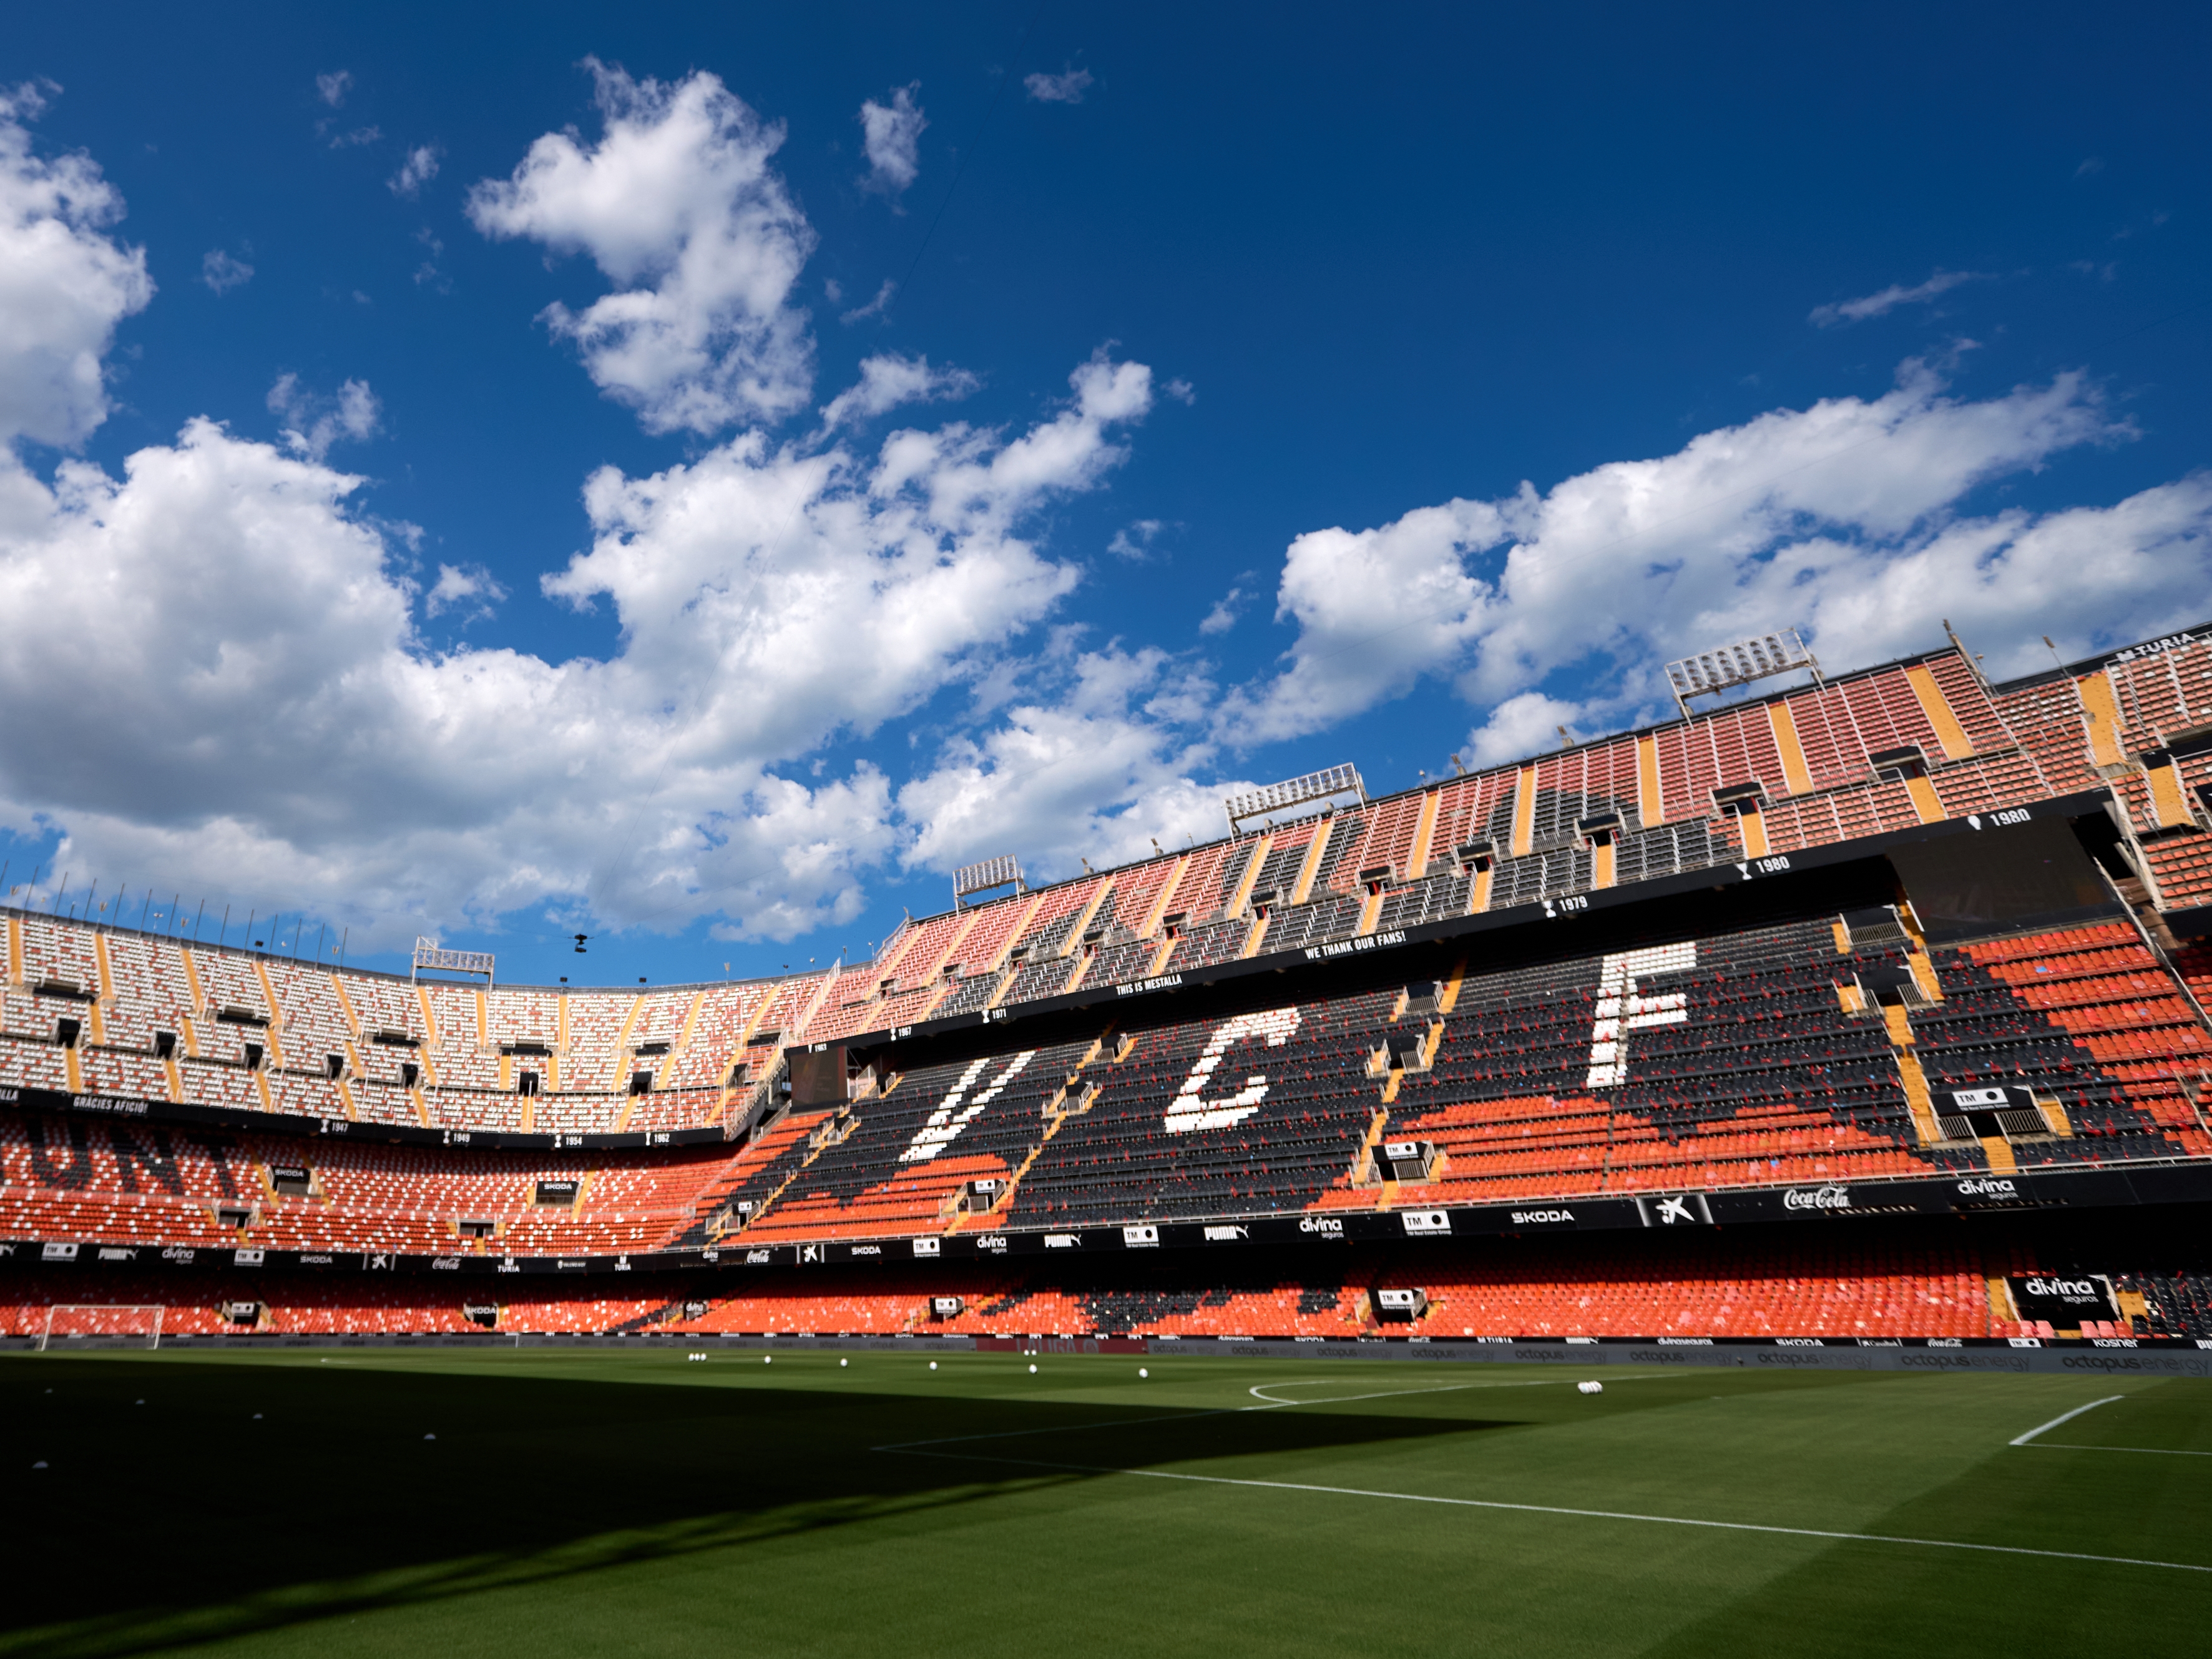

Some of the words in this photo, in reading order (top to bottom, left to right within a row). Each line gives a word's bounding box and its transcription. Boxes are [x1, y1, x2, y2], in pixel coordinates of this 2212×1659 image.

[2134, 633, 2196, 655] TURIA
[1989, 808, 2032, 826] 1980
[1755, 856, 1790, 874] 1980
[1559, 895, 1588, 912] 1979
[1304, 947, 1321, 960] WE
[1322, 941, 1353, 957] THANK
[1354, 936, 1376, 951] OUR
[1376, 930, 1406, 946] FANS!
[1115, 984, 1133, 996] THIS
[1135, 982, 1143, 992] IS
[1144, 974, 1182, 991] MESTALLA
[992, 1009, 1007, 1019] 1971
[898, 1027, 912, 1037] 1967
[0, 1088, 19, 1101] LLA
[1958, 1095, 1976, 1103] TM
[73, 1095, 112, 1110] GRÀCIES
[114, 1100, 149, 1113] AFICIÓ!
[331, 1122, 349, 1133] 1947
[453, 1133, 471, 1143] 1949
[565, 1136, 582, 1145] 1954
[654, 1133, 670, 1143] 1962
[1957, 1178, 2015, 1194] divina
[1783, 1186, 1852, 1210] Coca-Cola
[1987, 1190, 2019, 1200] seguros
[1299, 1217, 1343, 1232] divina
[1407, 1217, 1422, 1226] TM
[1127, 1231, 1138, 1240] TM
[1204, 1225, 1238, 1241] PUMA
[977, 1236, 1007, 1248] divina
[1044, 1234, 1072, 1248] PUMA
[162, 1246, 195, 1259] divina
[497, 1265, 521, 1273] TURIA
[2025, 1276, 2095, 1295] divina
[2062, 1296, 2099, 1304] seguros
[1231, 1345, 1268, 1357] octopus
[1317, 1348, 1358, 1359] octopus
[1411, 1349, 1456, 1361] octopus
[1515, 1349, 1564, 1362] octopus
[1630, 1350, 1685, 1364] octopus
[1685, 1352, 1731, 1366] energy
[1758, 1352, 1819, 1367] octopus
[1819, 1354, 1872, 1369] energy
[1901, 1354, 1971, 1369] octopus
[1972, 1356, 2030, 1372] energy
[2062, 1355, 2141, 1372] octopus
[2142, 1358, 2208, 1375] energy
